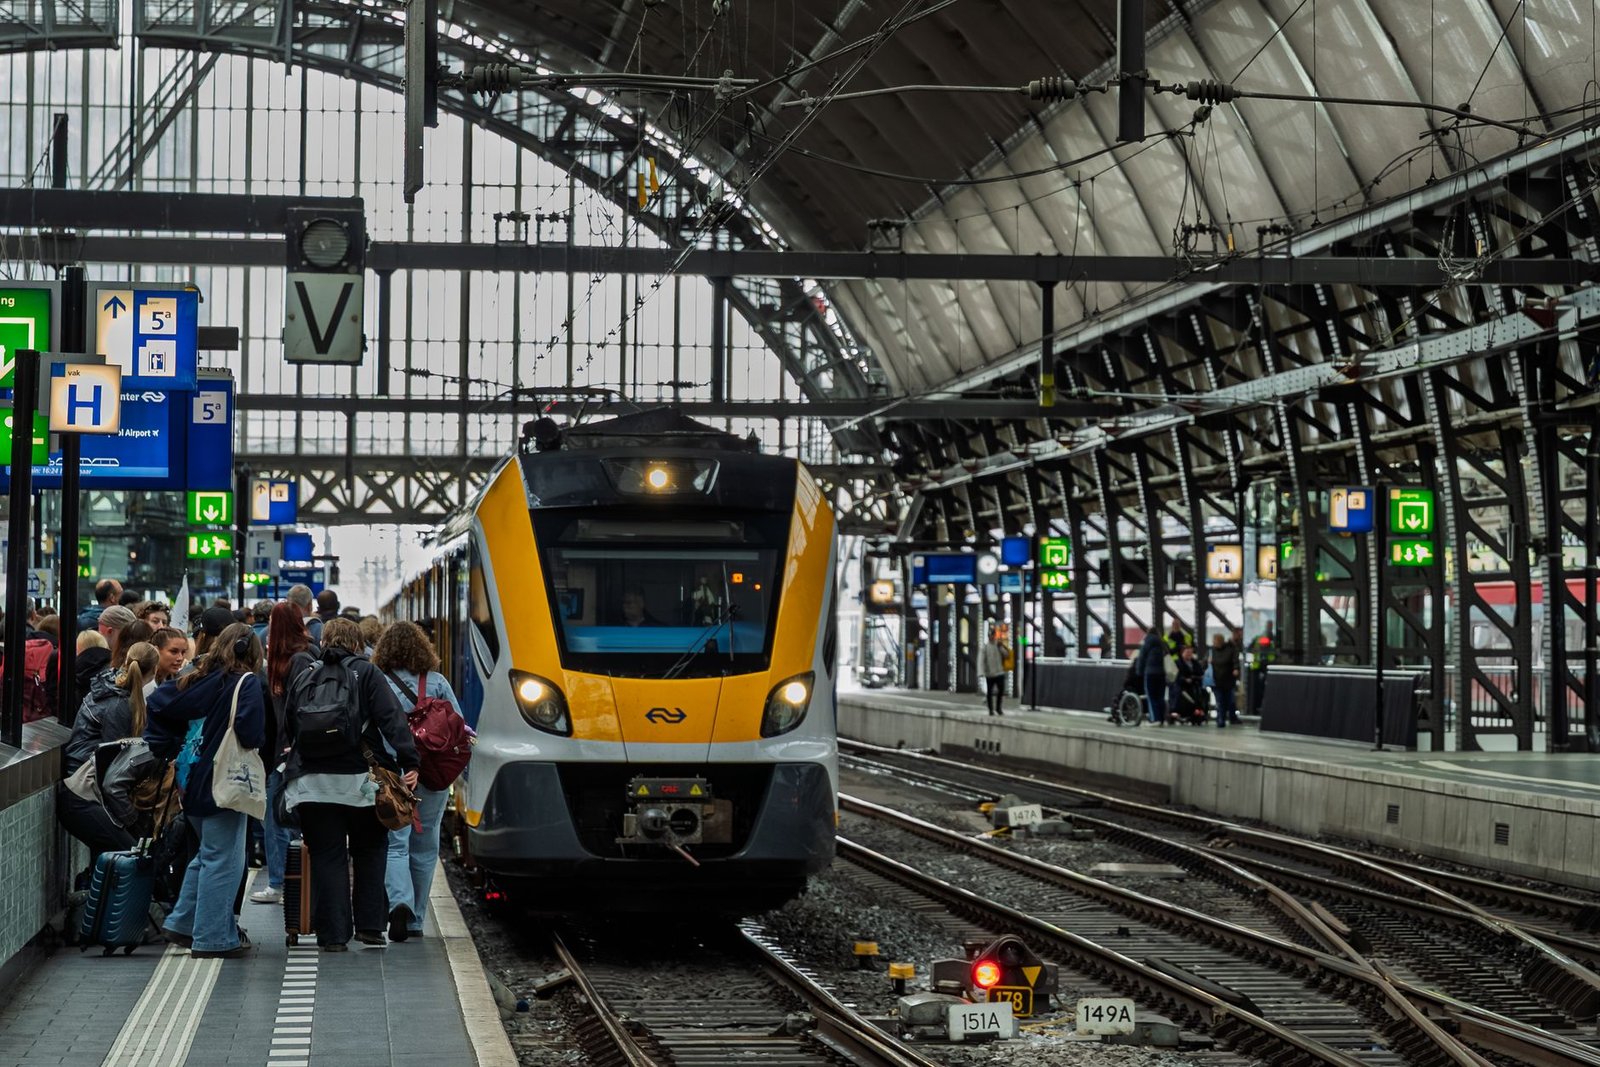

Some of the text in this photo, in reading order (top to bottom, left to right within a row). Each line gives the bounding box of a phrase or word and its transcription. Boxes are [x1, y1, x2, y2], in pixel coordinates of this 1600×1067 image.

[1, 297, 15, 308] ng
[294, 281, 355, 355] V
[67, 369, 81, 377] vak
[120, 391, 140, 402] nter
[66, 384, 103, 426] H
[125, 428, 151, 439] Airport
[256, 541, 266, 555] F
[1013, 809, 1038, 821] 147A
[1083, 1004, 1132, 1023] 149A
[961, 1012, 1001, 1031] 151A
